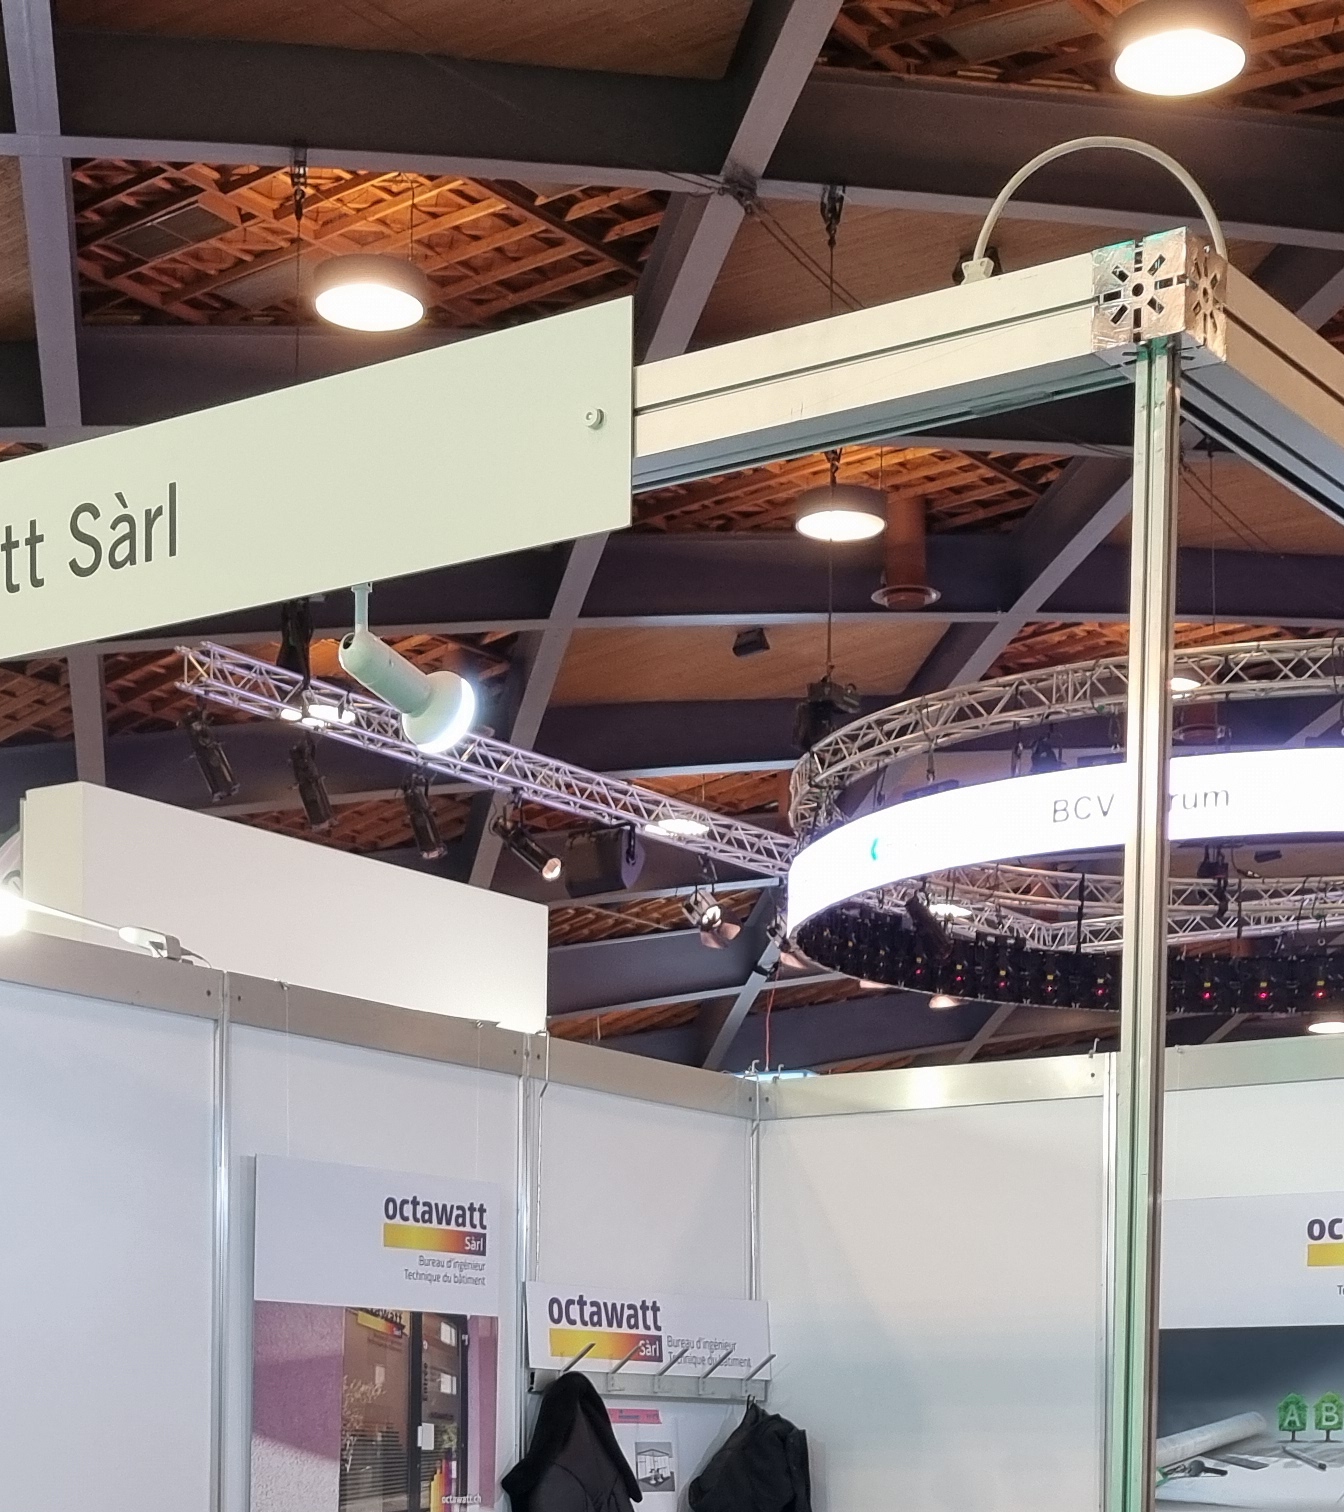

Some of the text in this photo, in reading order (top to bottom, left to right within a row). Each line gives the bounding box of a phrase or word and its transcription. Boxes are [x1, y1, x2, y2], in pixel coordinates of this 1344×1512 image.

[67, 481, 178, 578] Sàrl
[1052, 793, 1115, 824] BCV
[384, 1195, 487, 1230] octawatt
[464, 1236, 484, 1251] Sàrl
[418, 1255, 445, 1268] Bureau
[404, 1268, 486, 1286] Technique du bâtiment
[548, 1294, 662, 1331] octawatt
[638, 1340, 660, 1357] Sàrl
[666, 1335, 694, 1351] Bureau
[1283, 1401, 1300, 1427] A
[1320, 1401, 1338, 1427] B
